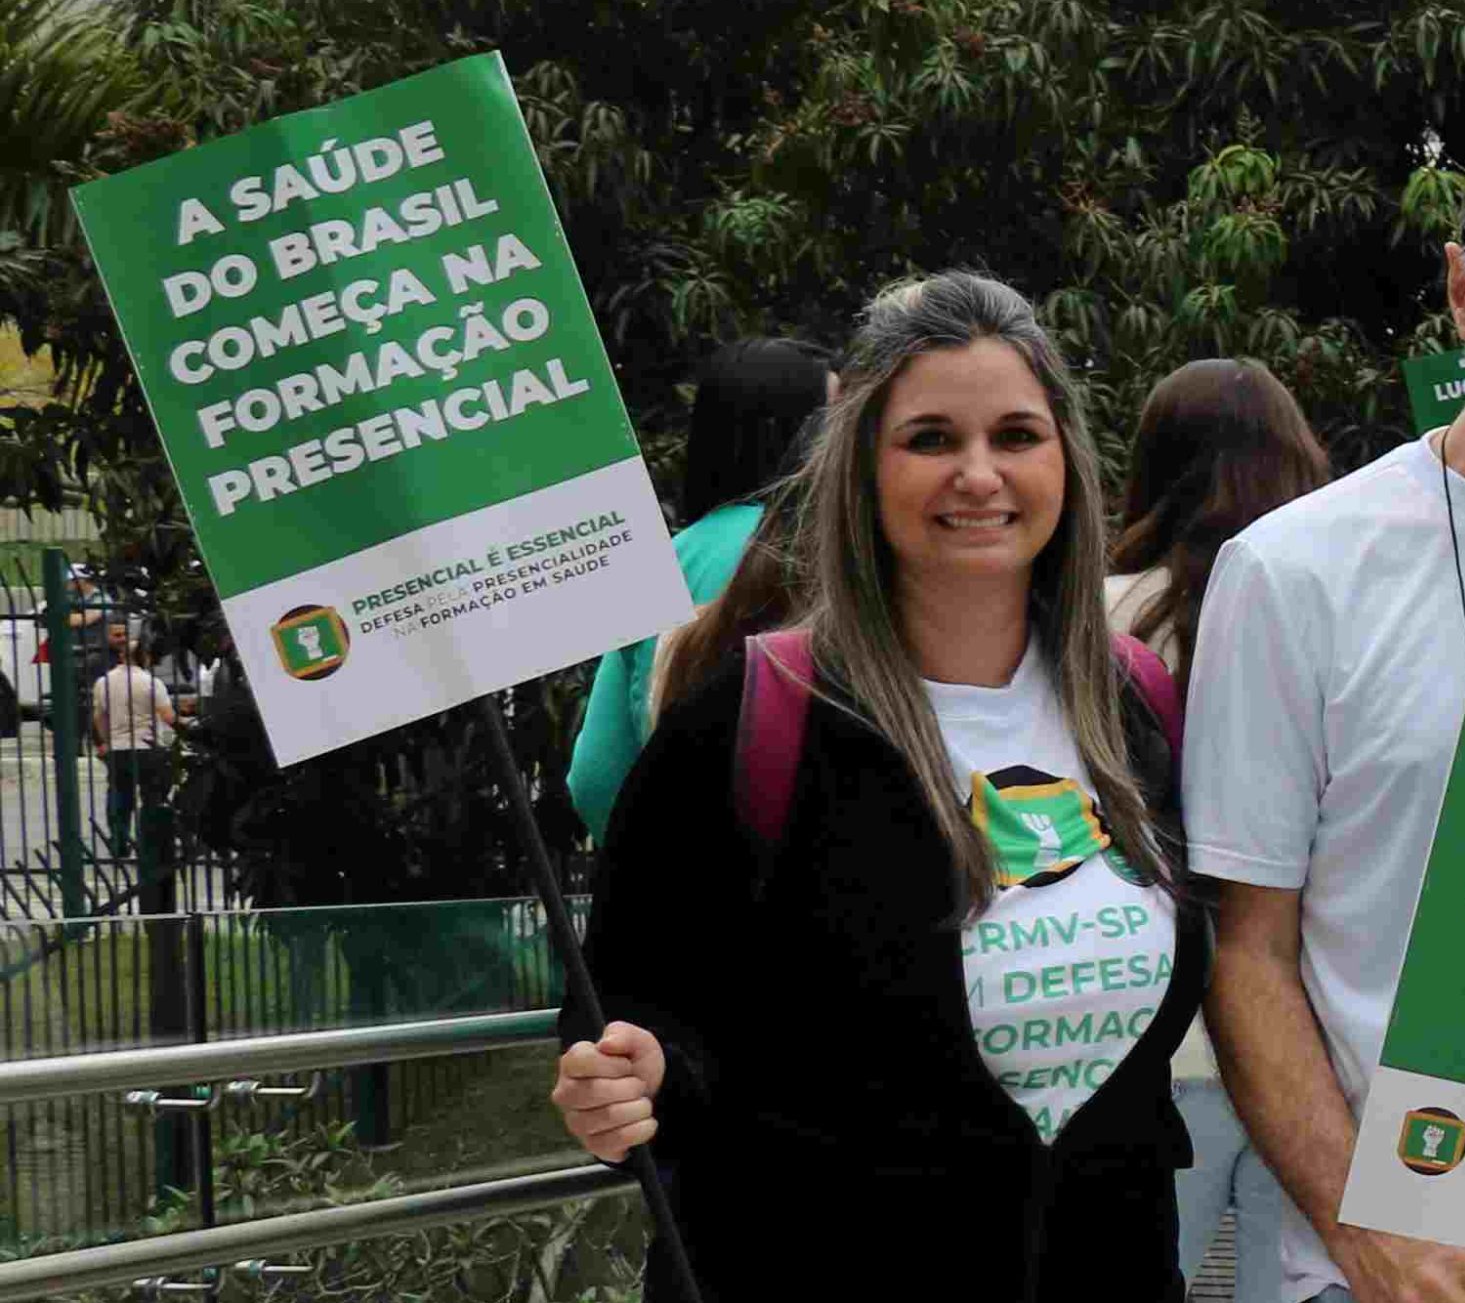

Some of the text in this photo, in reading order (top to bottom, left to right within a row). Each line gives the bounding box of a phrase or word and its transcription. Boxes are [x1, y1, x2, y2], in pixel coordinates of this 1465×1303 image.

[176, 120, 447, 246] A SAÚDE
[162, 177, 499, 319] DO BRASIL
[167, 234, 543, 385] COMEÇA NA
[198, 296, 551, 450] FORMAÇÃO
[207, 358, 590, 518] PRESENCIAL
[352, 511, 625, 616] PRESENCIAL É ESSENCIAL
[360, 529, 633, 634] DEFESA PRESENCIALIDADE
[420, 588, 516, 629] FORMAÇÃO
[522, 577, 548, 595] EM
[1003, 953, 1173, 1004] DEFESA
